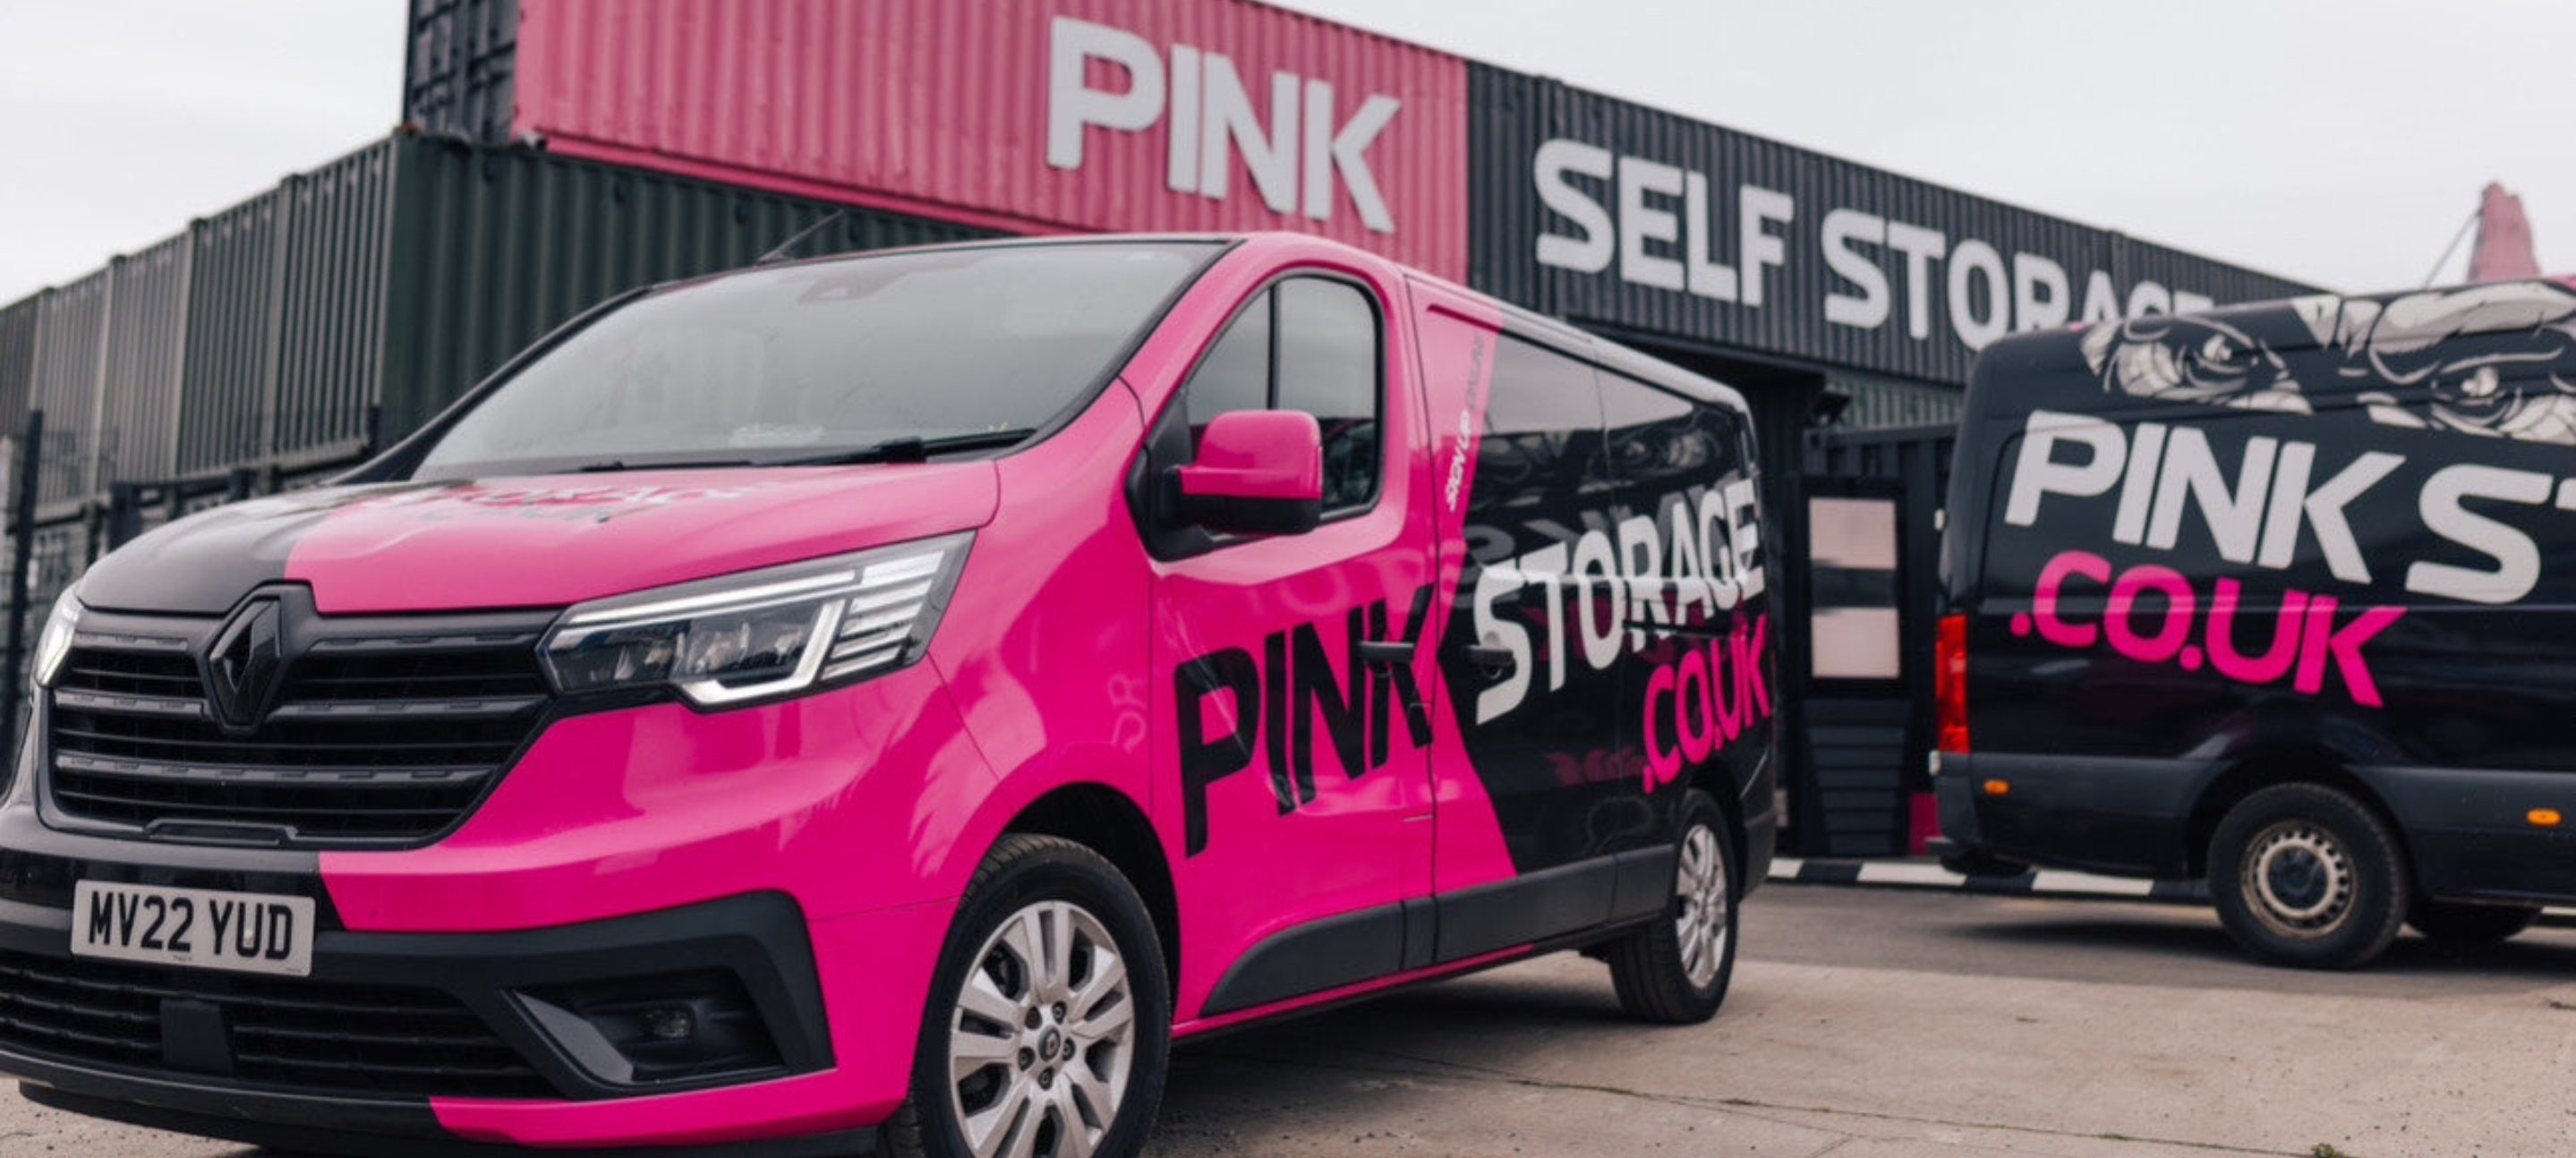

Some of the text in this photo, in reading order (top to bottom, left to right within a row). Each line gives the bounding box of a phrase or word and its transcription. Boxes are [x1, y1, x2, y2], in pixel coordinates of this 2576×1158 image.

[1046, 15, 1401, 234] PINK
[1534, 138, 1793, 307] SELF
[2005, 409, 2576, 603] PINK S
[1173, 480, 1765, 859] PINK STORAGE
[1643, 614, 1770, 795] .CO.UK
[2011, 550, 2408, 707] .CO.UK
[89, 890, 293, 960] MV22 YUD
